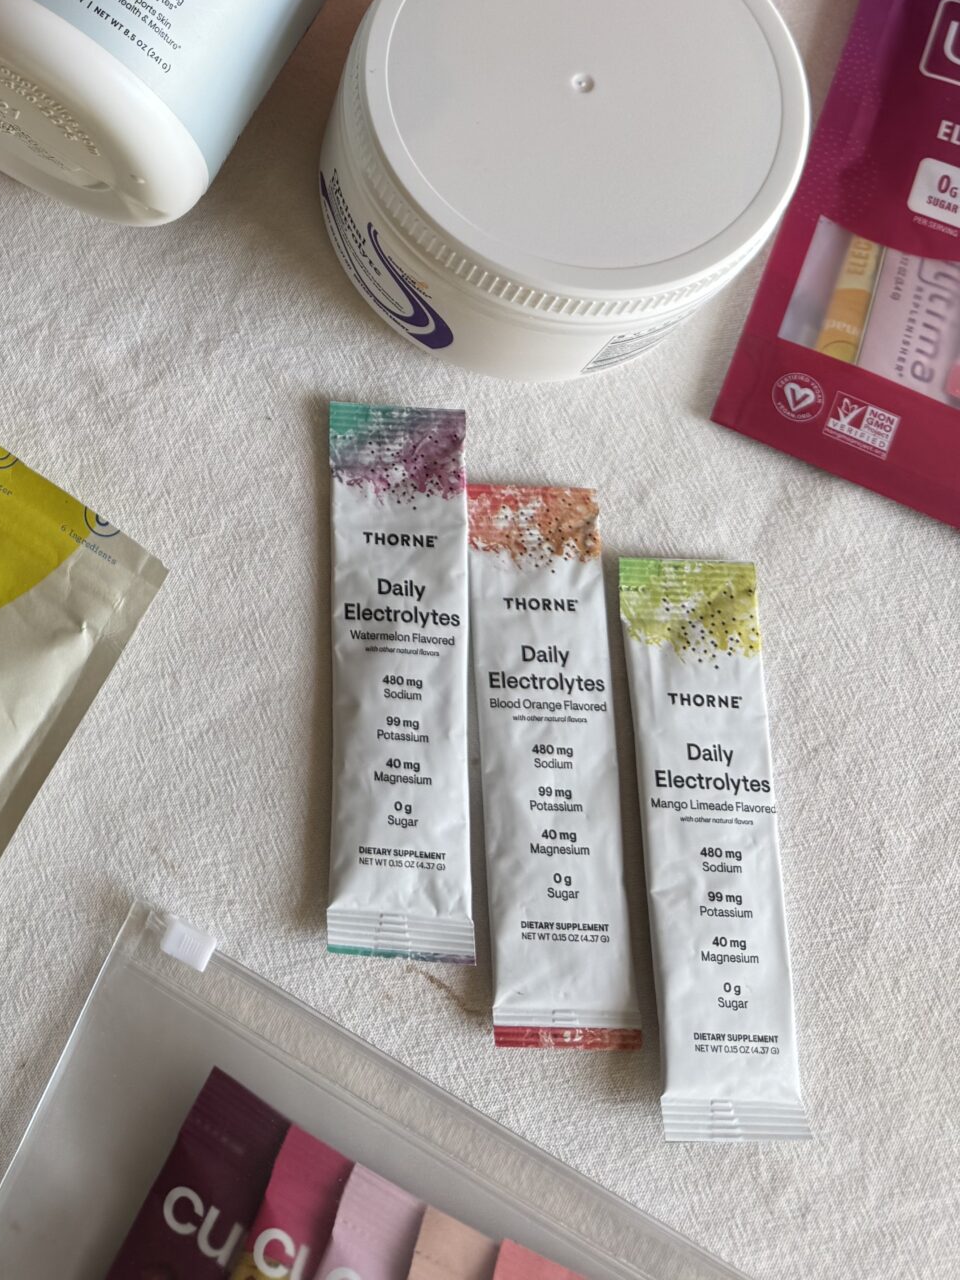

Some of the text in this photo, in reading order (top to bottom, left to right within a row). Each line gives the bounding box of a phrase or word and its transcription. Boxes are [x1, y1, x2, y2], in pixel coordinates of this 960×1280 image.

[93, 4, 112, 22] NET
[110, 17, 125, 32] WT
[122, 27, 137, 42] 8.5
[135, 38, 149, 53] OZ
[155, 11, 173, 31] Skin
[926, 195, 959, 214] SUGAR
[865, 417, 893, 433] GMO
[868, 408, 895, 426] NON
[831, 421, 887, 449] VERIFIED
[67, 528, 118, 566] Ingredients
[377, 577, 426, 602] Daily
[344, 602, 461, 629] Electrolytes
[350, 629, 456, 646] Watermelon Flavored
[521, 644, 570, 668] Daily
[382, 674, 424, 690] 480 mg
[488, 671, 606, 695] Electrolytes
[383, 688, 423, 702] Sodium
[489, 697, 608, 713] Blood Orange Flavored
[386, 715, 420, 730] 99 mg
[376, 729, 430, 744] Potassium
[686, 742, 735, 768] Daily
[385, 758, 421, 773] 40 mg
[373, 771, 433, 786] Magnesium
[654, 769, 771, 797] Electrolytes
[393, 800, 413, 815] 0 g
[650, 797, 689, 813] Mango
[689, 799, 735, 813] Limeade
[386, 814, 419, 829] Sugar
[358, 845, 447, 861] DIETARY SUPPLEMENT
